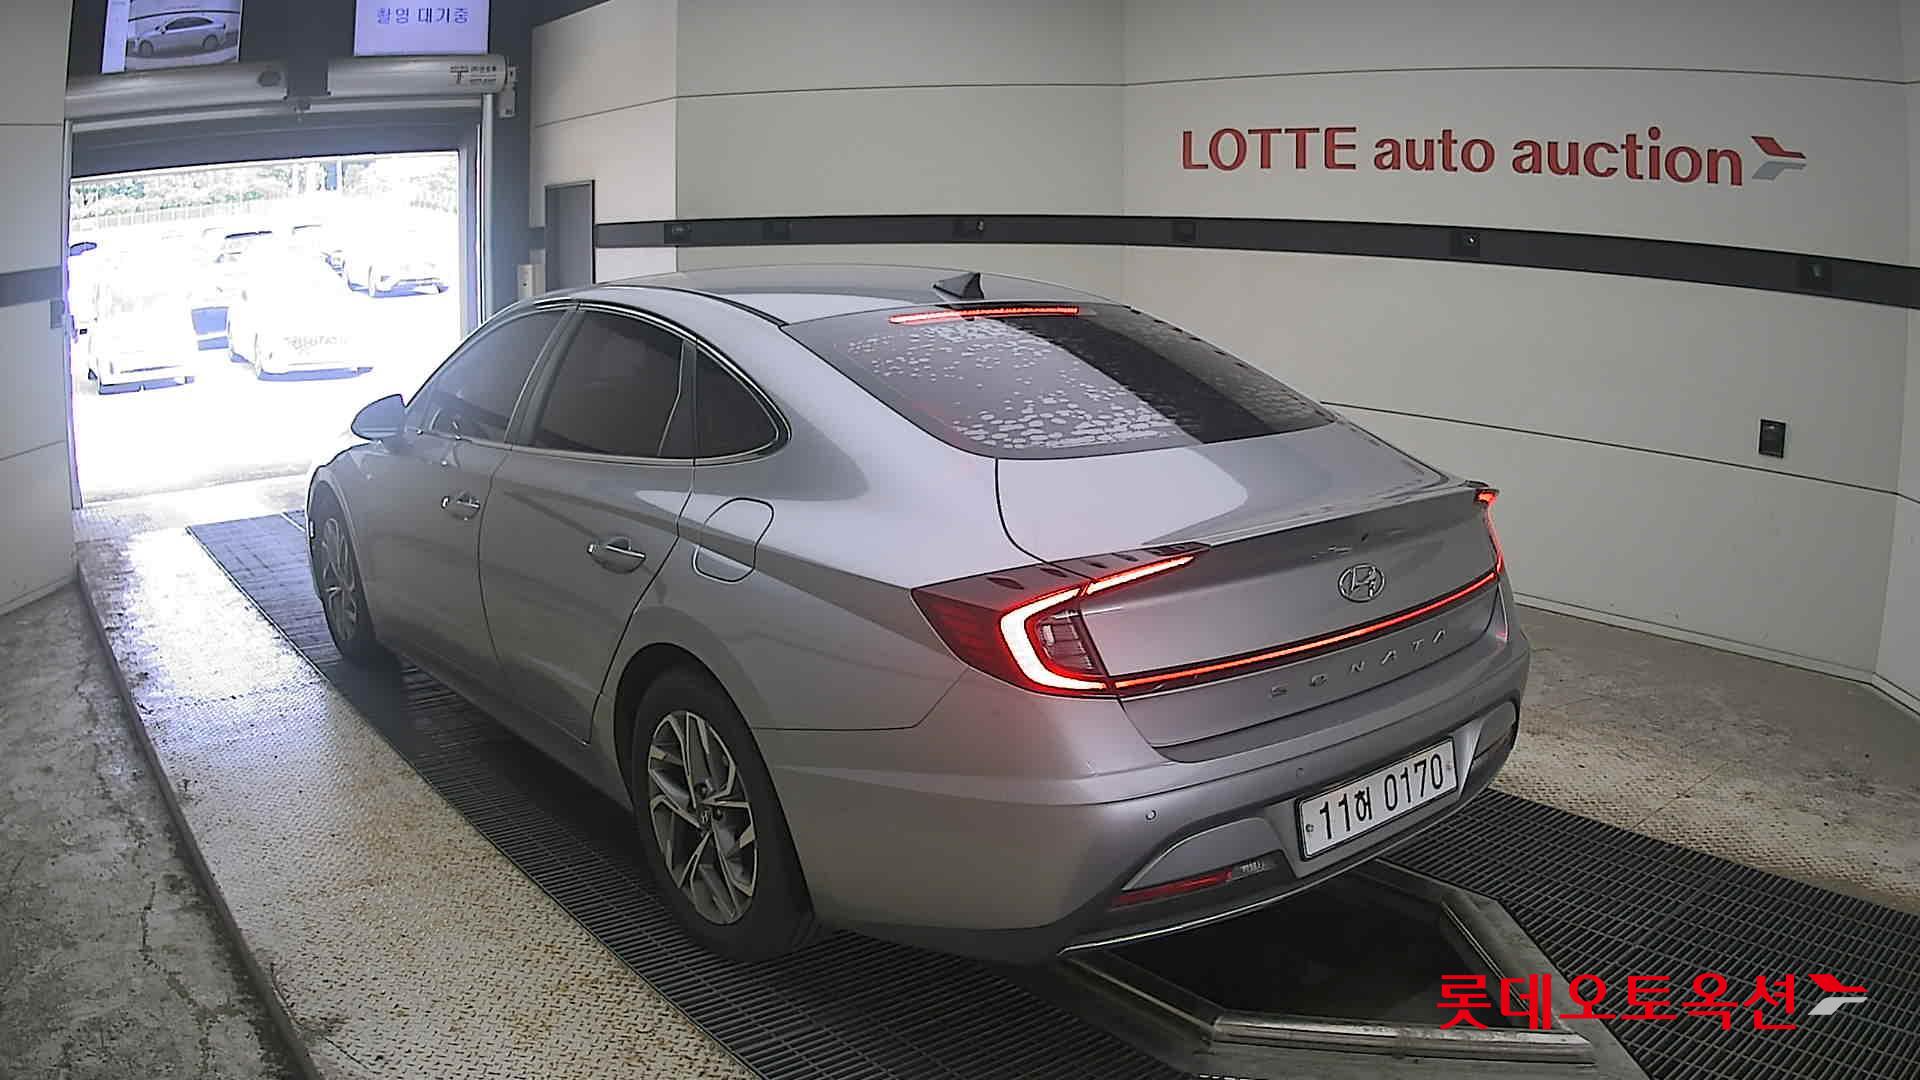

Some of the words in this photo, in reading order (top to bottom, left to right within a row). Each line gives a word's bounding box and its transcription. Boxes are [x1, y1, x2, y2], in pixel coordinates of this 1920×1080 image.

[417, 7, 469, 24] 대기중
[1181, 126, 1358, 171] LOTTE
[1373, 129, 1496, 173] auto
[1511, 125, 1743, 187] auction
[1269, 629, 1446, 699] SONATA
[1319, 786, 1373, 840] 11허
[1384, 753, 1444, 812] 0170
